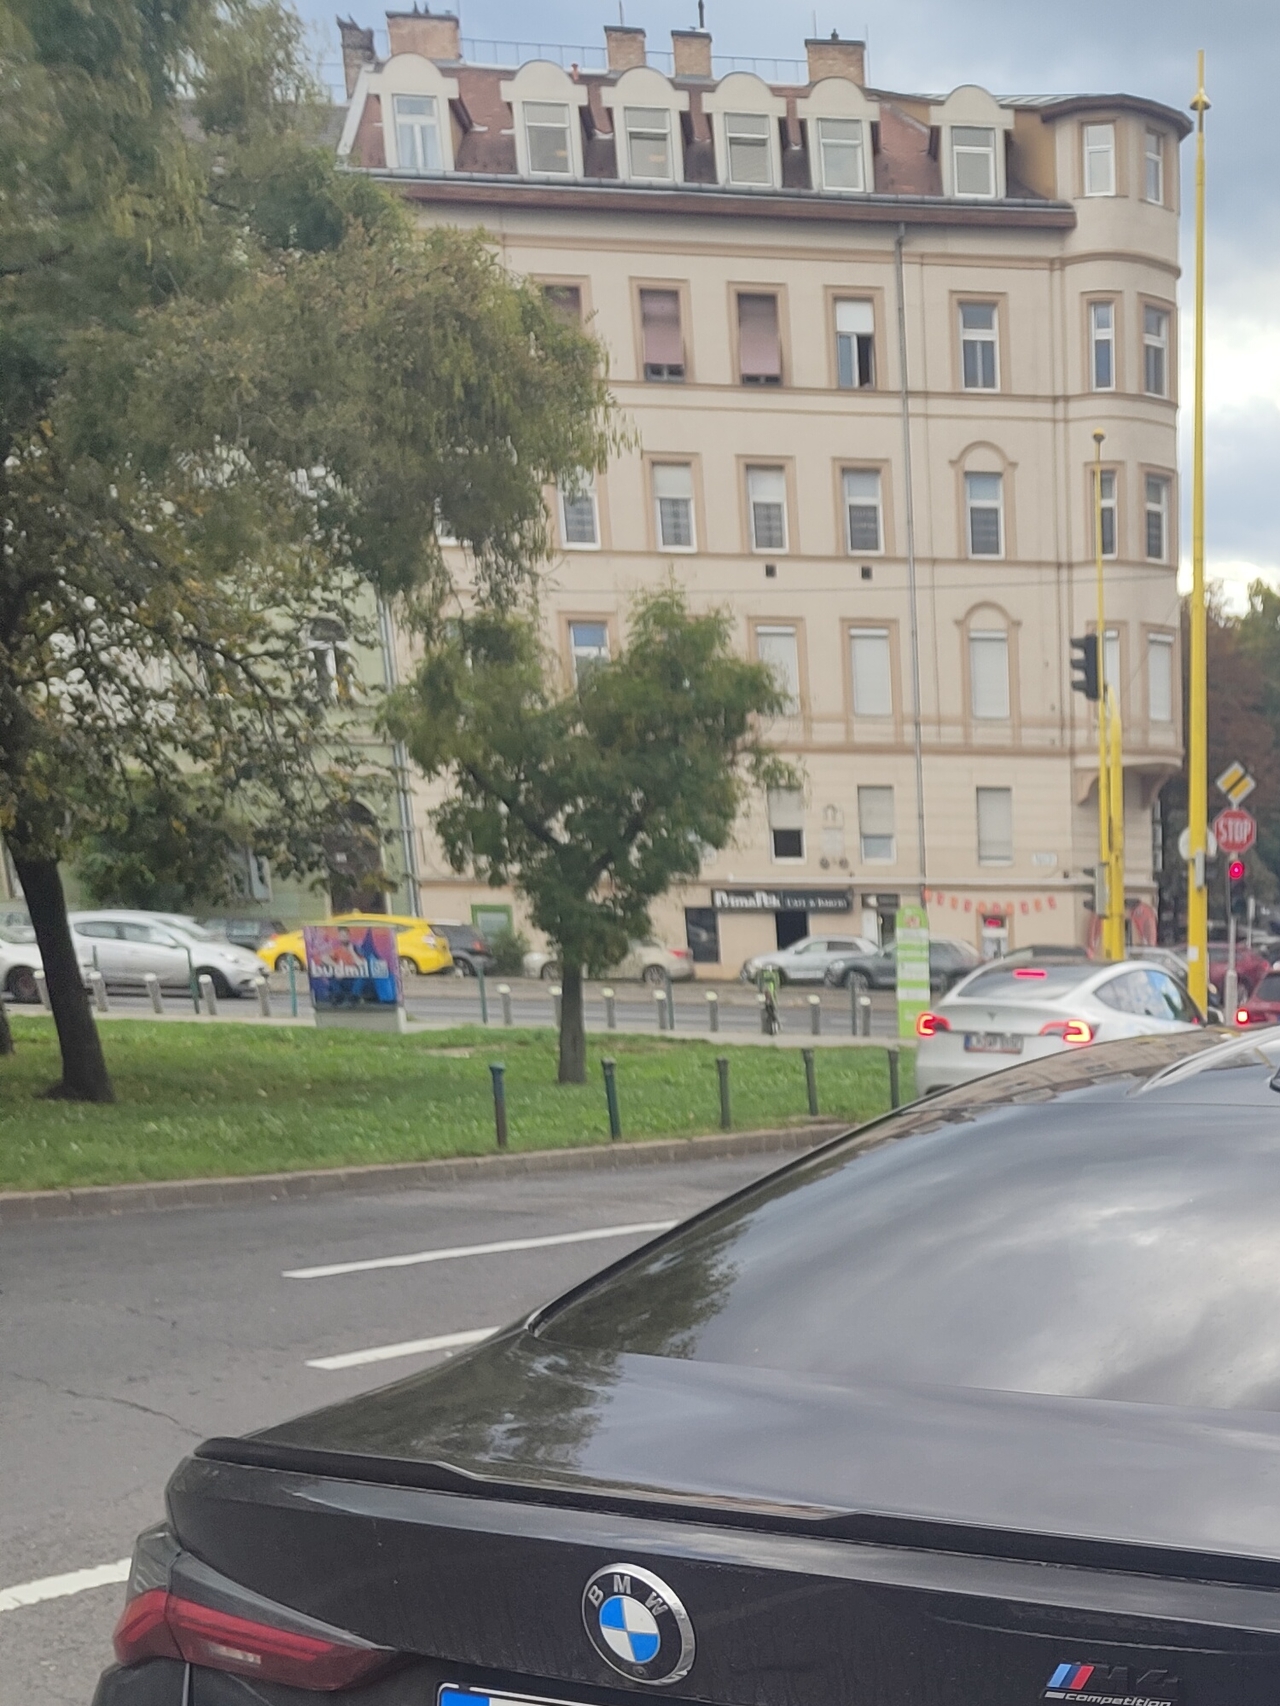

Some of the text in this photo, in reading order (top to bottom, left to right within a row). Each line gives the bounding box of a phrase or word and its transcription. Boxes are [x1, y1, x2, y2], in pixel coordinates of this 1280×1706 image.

[1218, 818, 1252, 844] STOP
[311, 957, 370, 978] budmil
[588, 1574, 668, 1616] BMW
